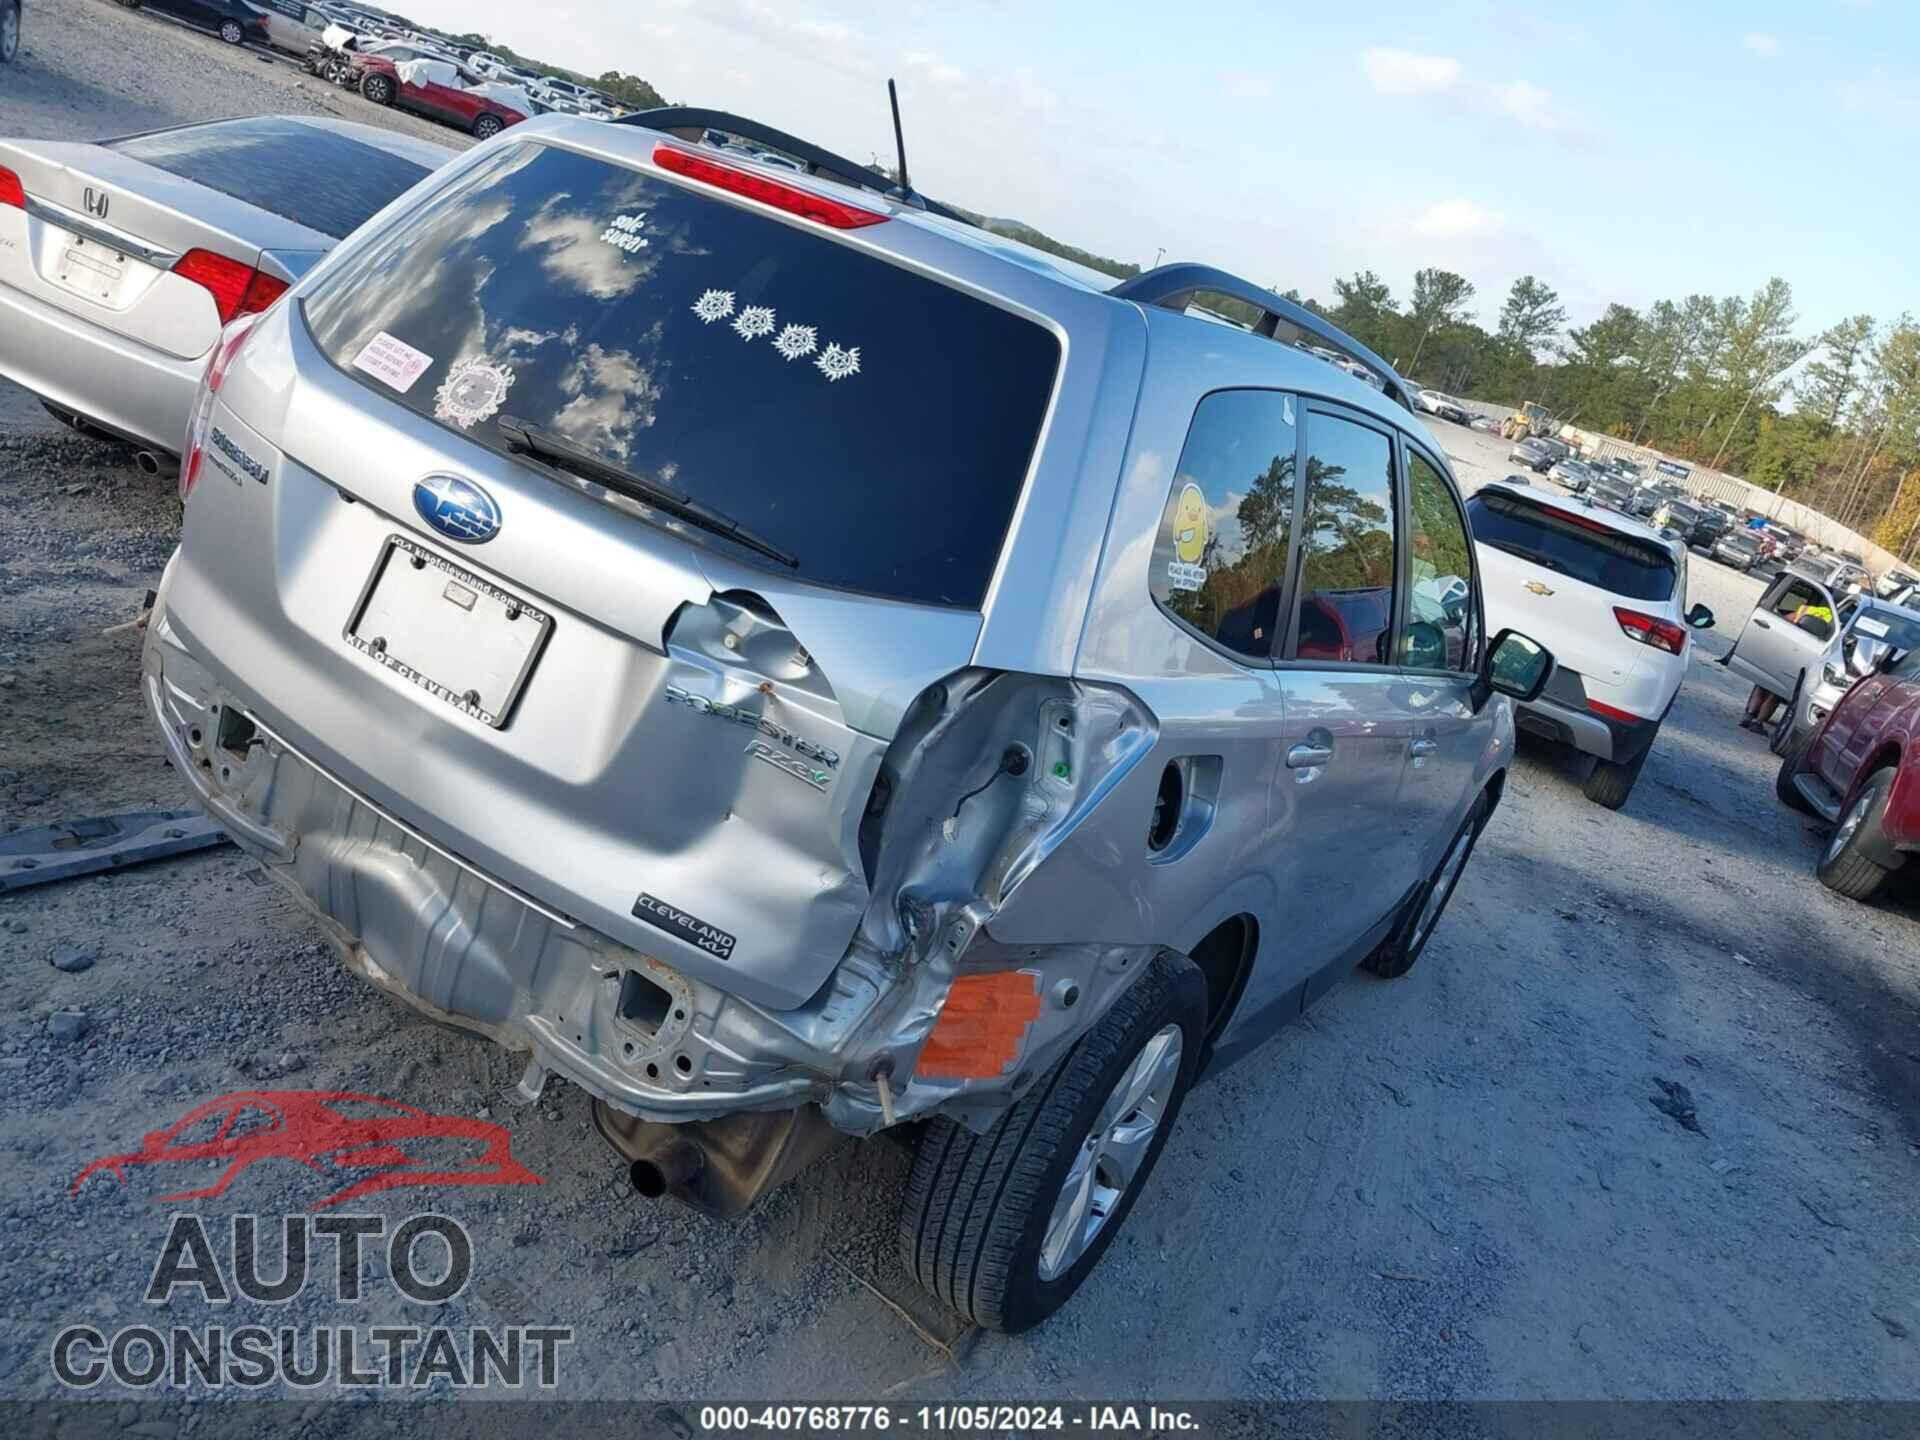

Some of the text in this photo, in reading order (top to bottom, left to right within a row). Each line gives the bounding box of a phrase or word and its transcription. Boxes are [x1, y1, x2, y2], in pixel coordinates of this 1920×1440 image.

[415, 546, 518, 609] kiaofcleveland.com
[346, 633, 493, 725] KIA OF CLEVELAND
[638, 896, 733, 948] CLEVELAND
